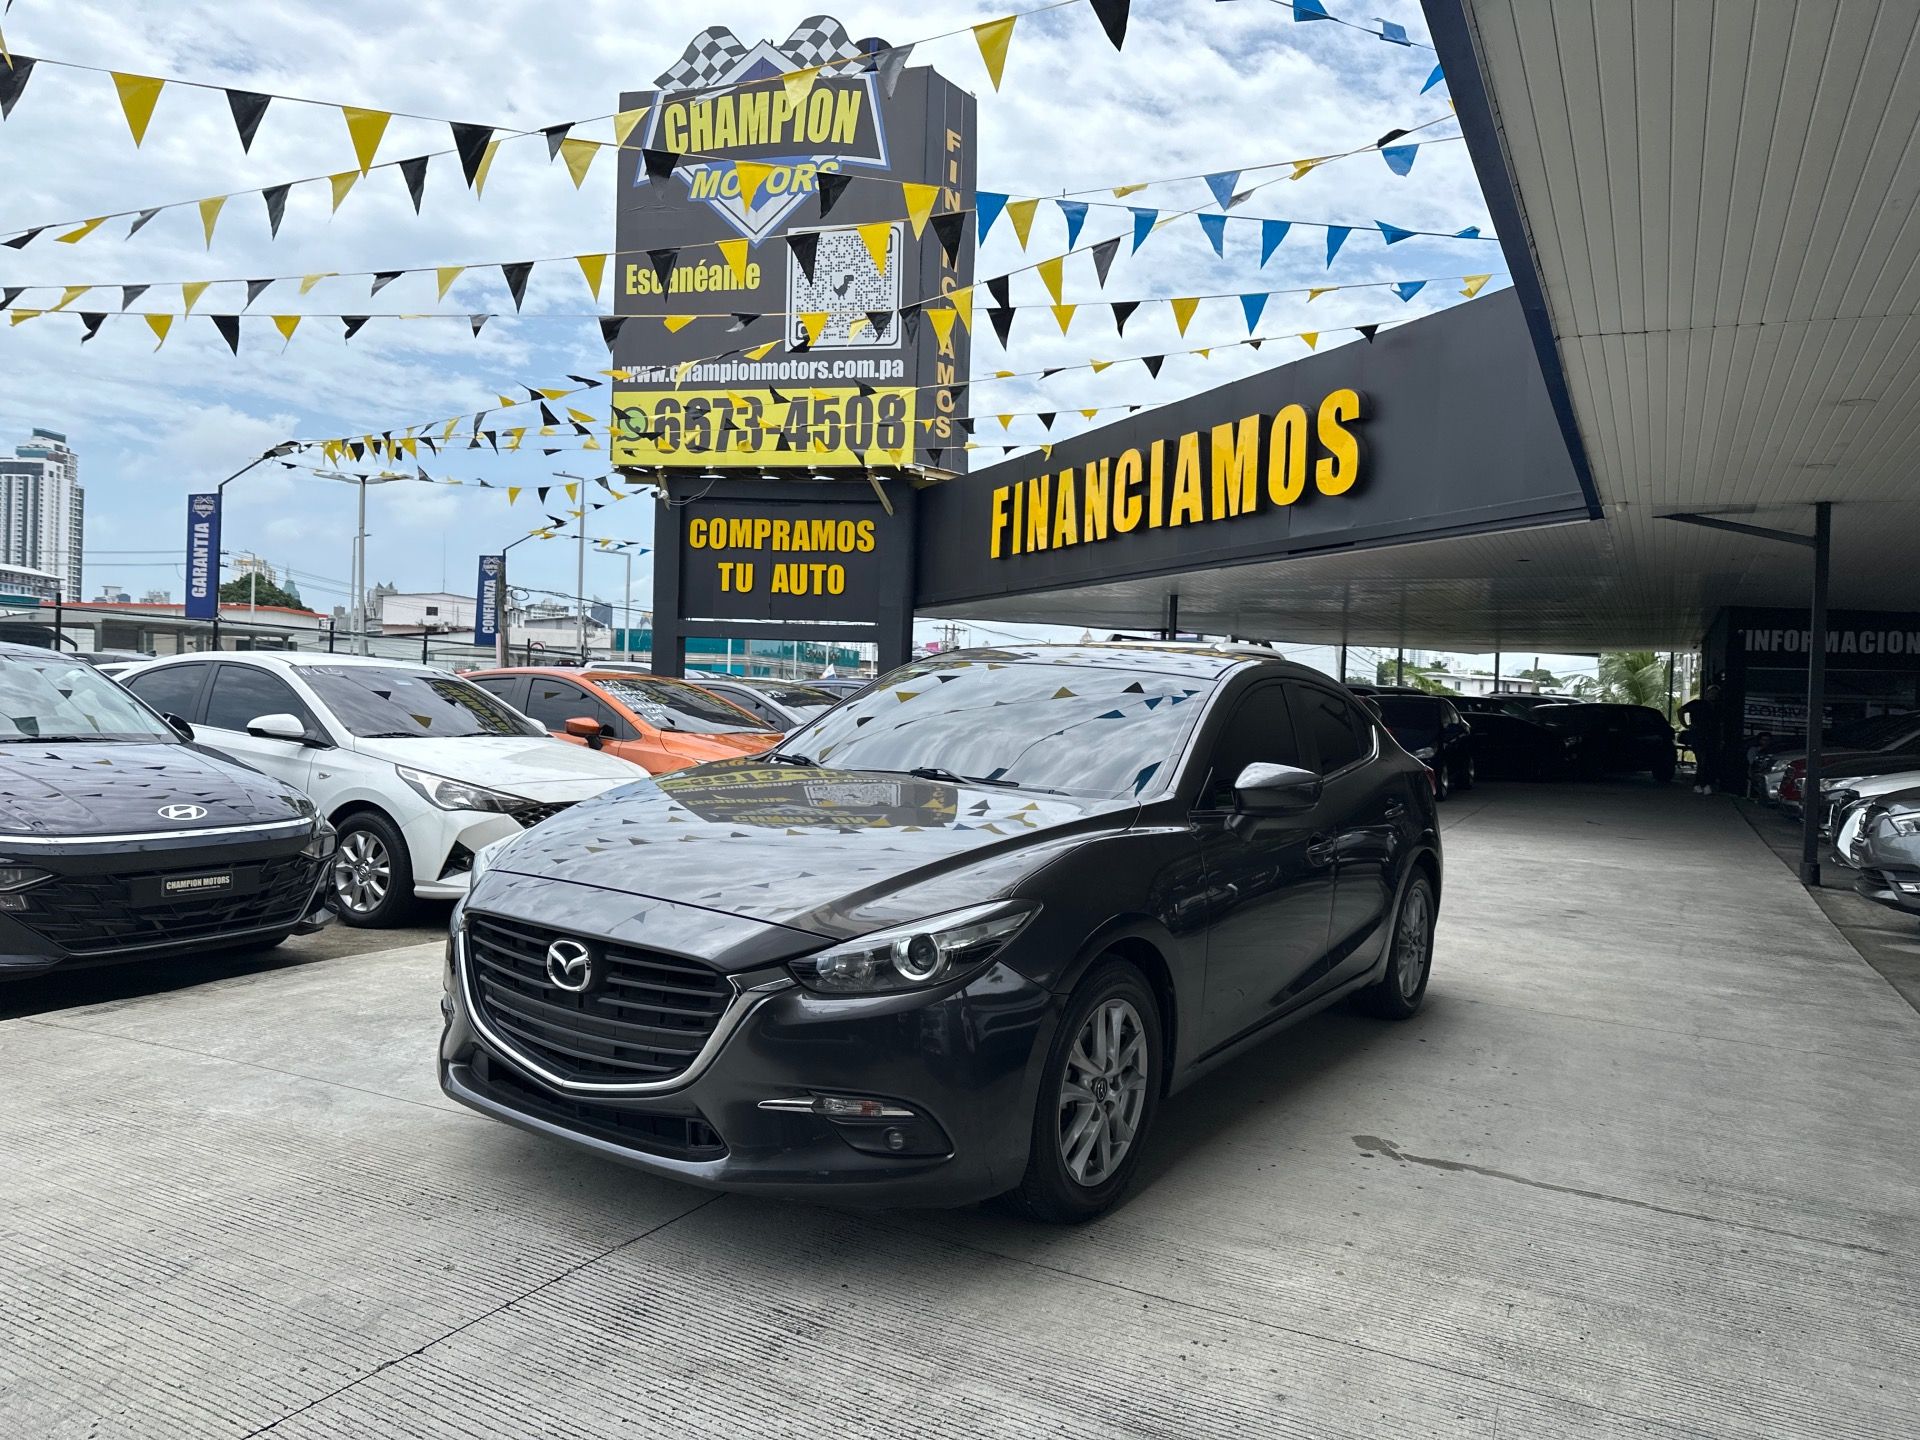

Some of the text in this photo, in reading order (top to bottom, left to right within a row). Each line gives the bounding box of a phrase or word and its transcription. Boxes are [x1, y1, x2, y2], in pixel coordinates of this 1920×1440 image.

[664, 88, 862, 155] CHAMPION
[690, 161, 839, 199] MOOR
[990, 388, 1362, 559] FINANCIAMOS
[689, 518, 876, 553] COMPRAMOS
[191, 522, 210, 598] GARANTIA
[718, 562, 846, 595] TU AUTO
[482, 579, 497, 634] CONFIANZA
[166, 879, 202, 890] CHAMPION
[203, 875, 230, 886] MOTORS
